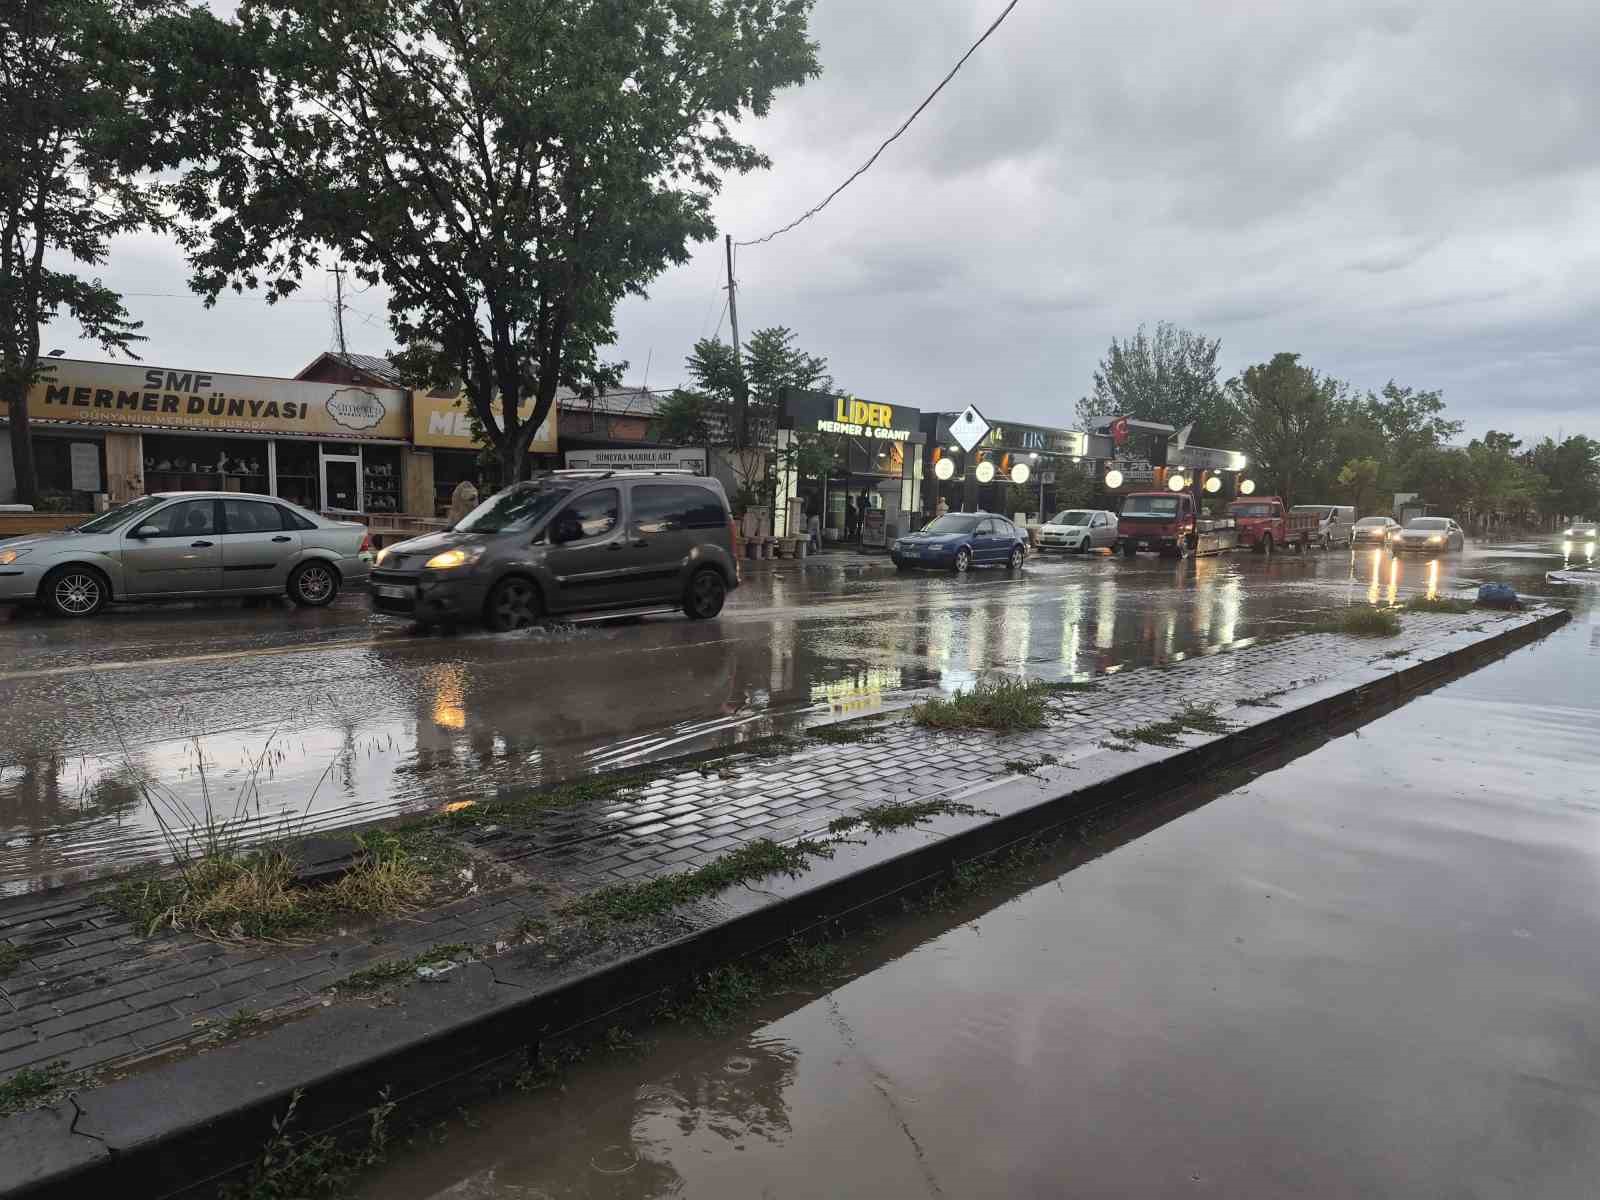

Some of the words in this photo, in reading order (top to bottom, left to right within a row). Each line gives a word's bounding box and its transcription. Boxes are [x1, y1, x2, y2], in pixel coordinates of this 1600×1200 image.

[144, 370, 212, 394] SMF
[45, 385, 180, 413] MERMER
[187, 392, 308, 420] DÜNYASI
[836, 394, 893, 428] LİDER
[817, 420, 863, 436] MERMER
[864, 427, 873, 437] &
[656, 451, 673, 462] ART
